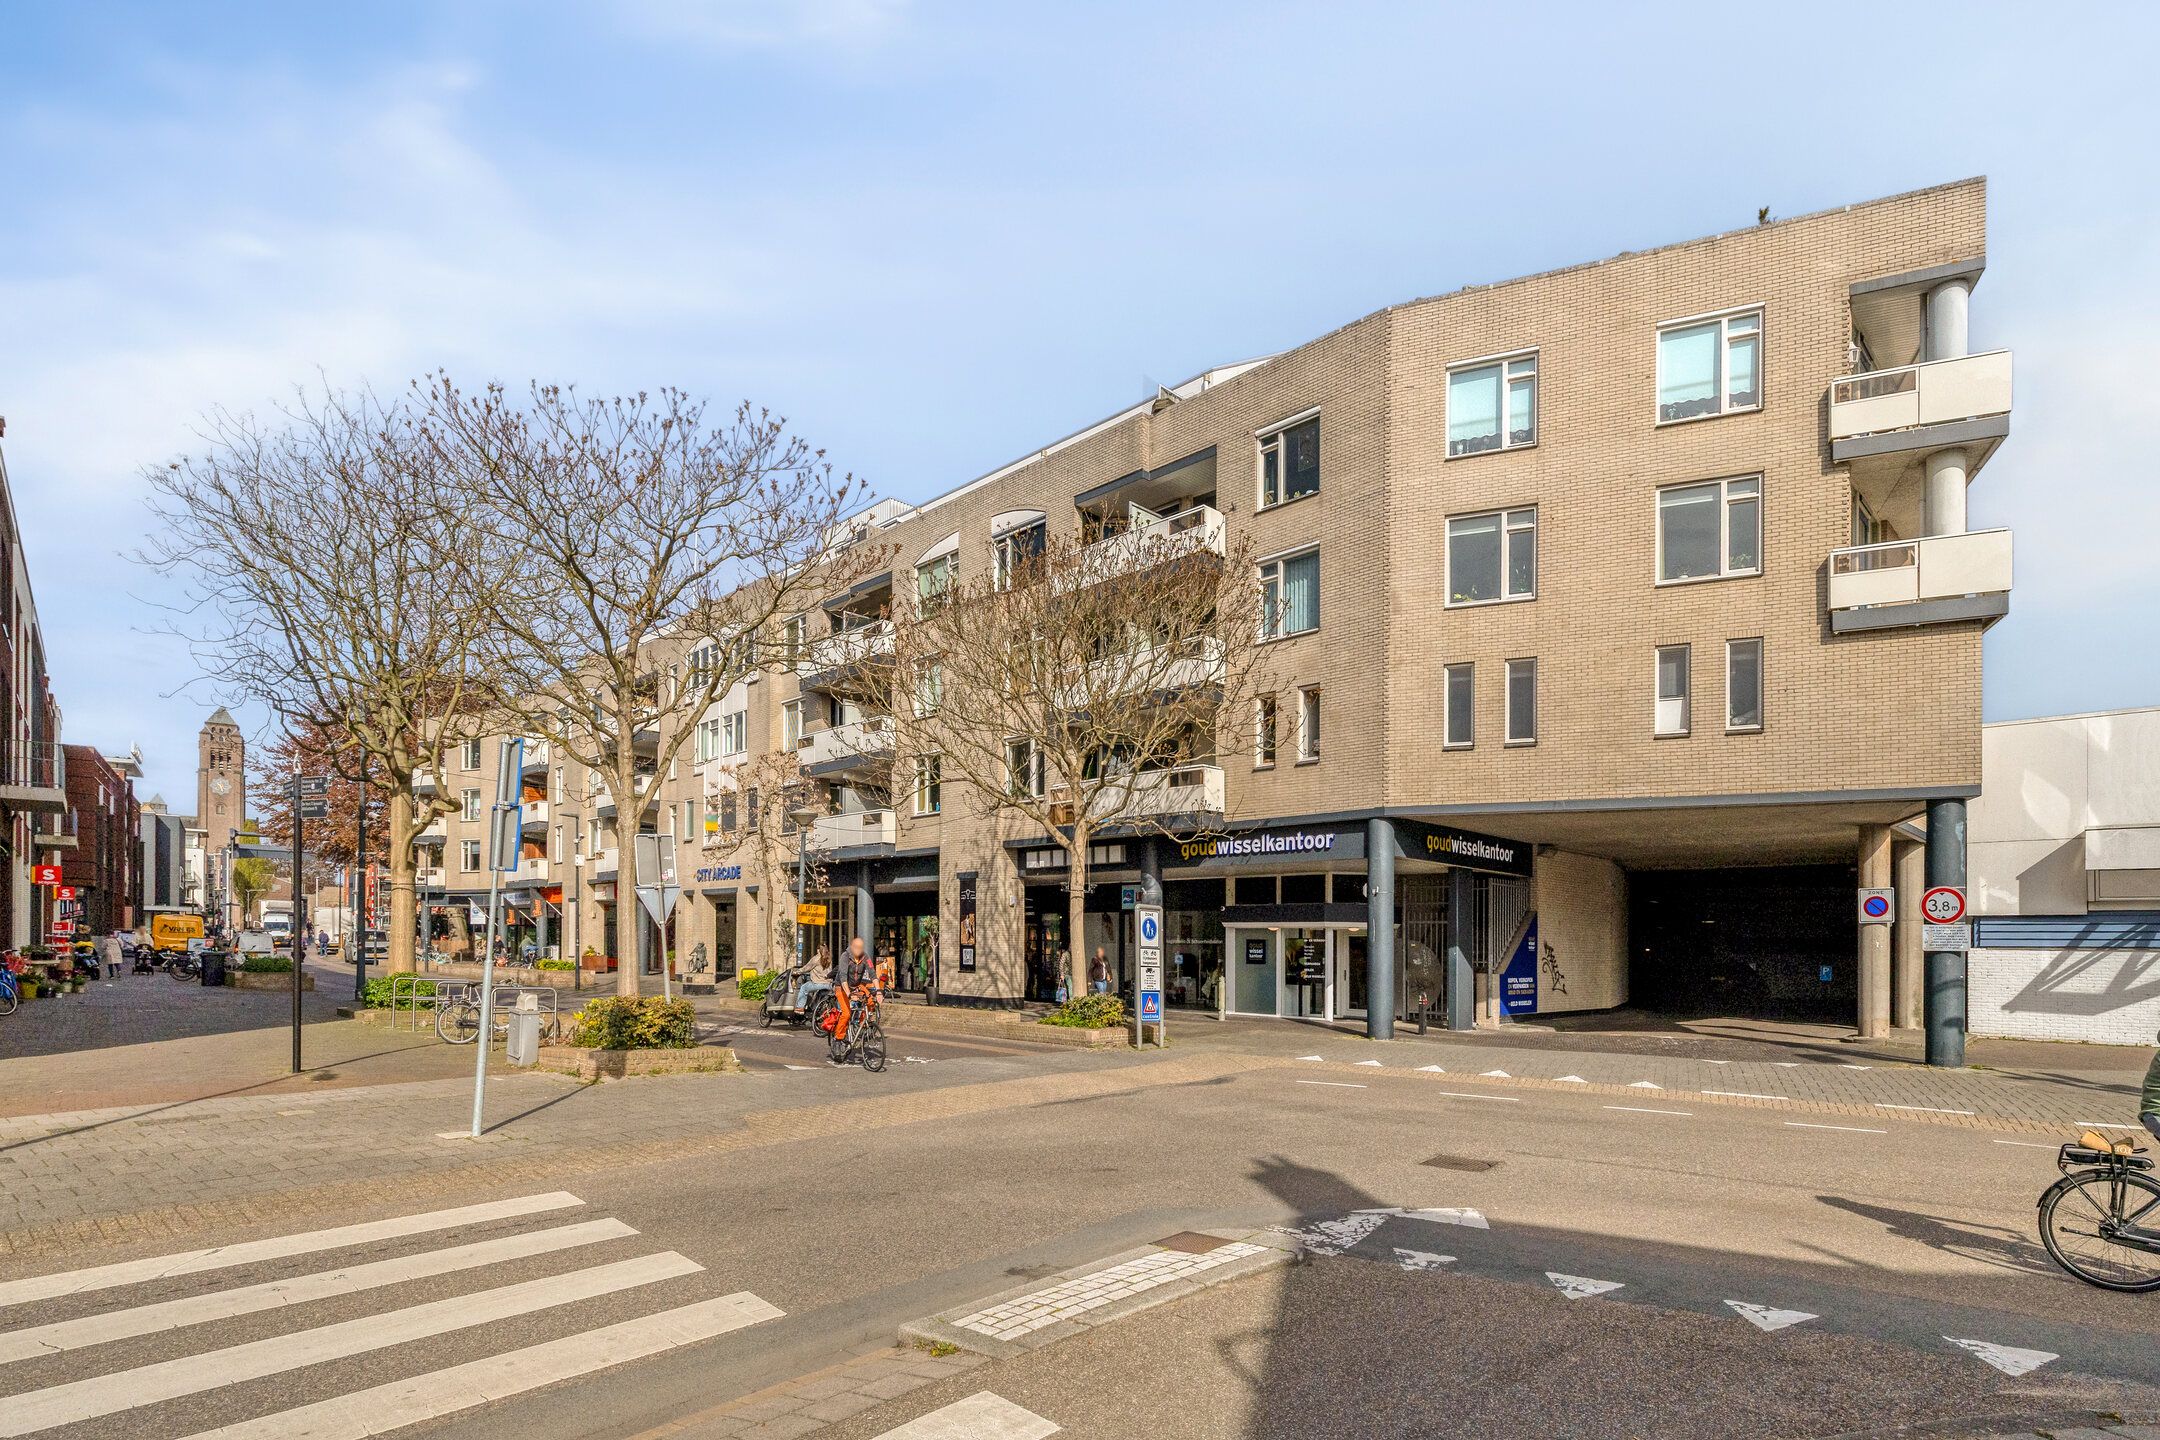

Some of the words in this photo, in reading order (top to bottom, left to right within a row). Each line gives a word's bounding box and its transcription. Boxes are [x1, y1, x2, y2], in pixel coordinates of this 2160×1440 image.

[1181, 831, 1335, 860] goudwisselkantoor
[1427, 835, 1514, 862] goudwisselkantoor
[43, 868, 56, 881] S
[713, 865, 742, 881] ARCADE
[61, 888, 71, 897] S
[1823, 967, 1830, 975] P
